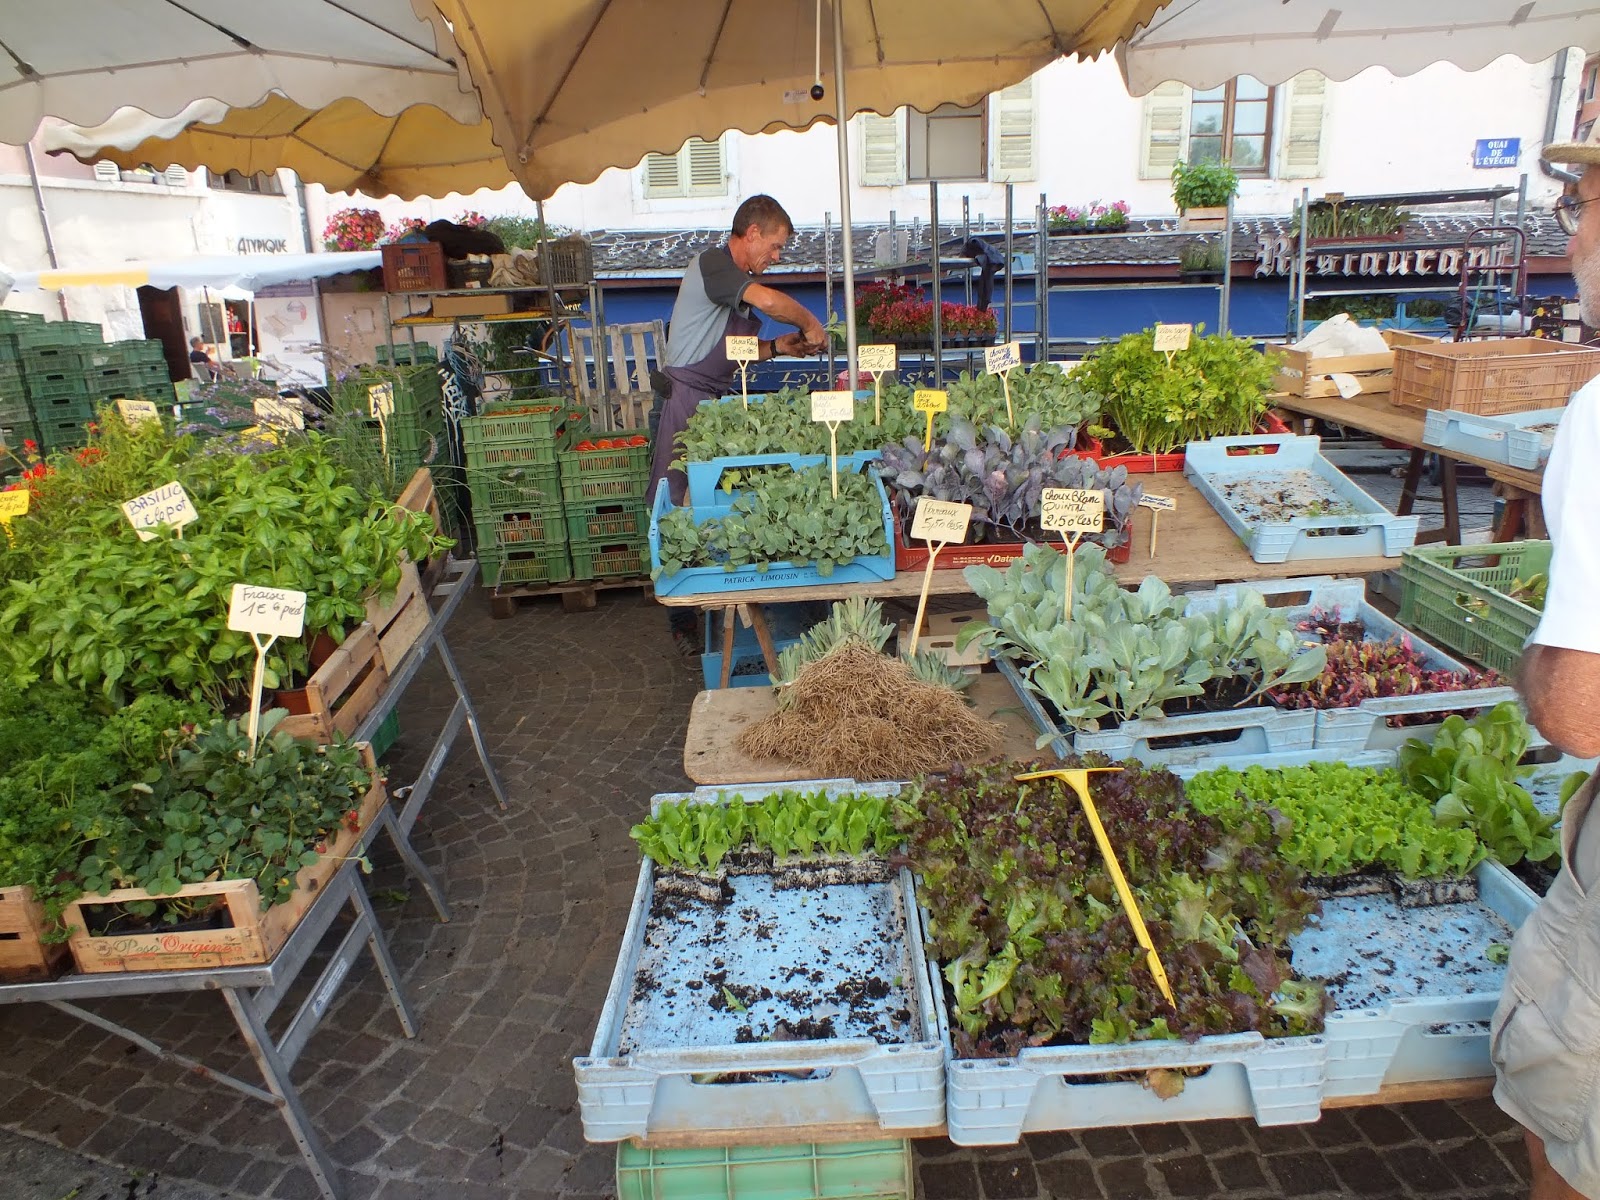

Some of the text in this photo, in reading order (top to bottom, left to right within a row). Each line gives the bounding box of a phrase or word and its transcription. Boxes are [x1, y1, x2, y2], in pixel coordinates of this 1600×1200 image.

[1488, 141, 1508, 149] QUAI
[1491, 149, 1503, 157] DE
[127, 485, 182, 516] BASILIC
[723, 575, 756, 585] PATRICK
[760, 571, 800, 582] LIMOUSIN
